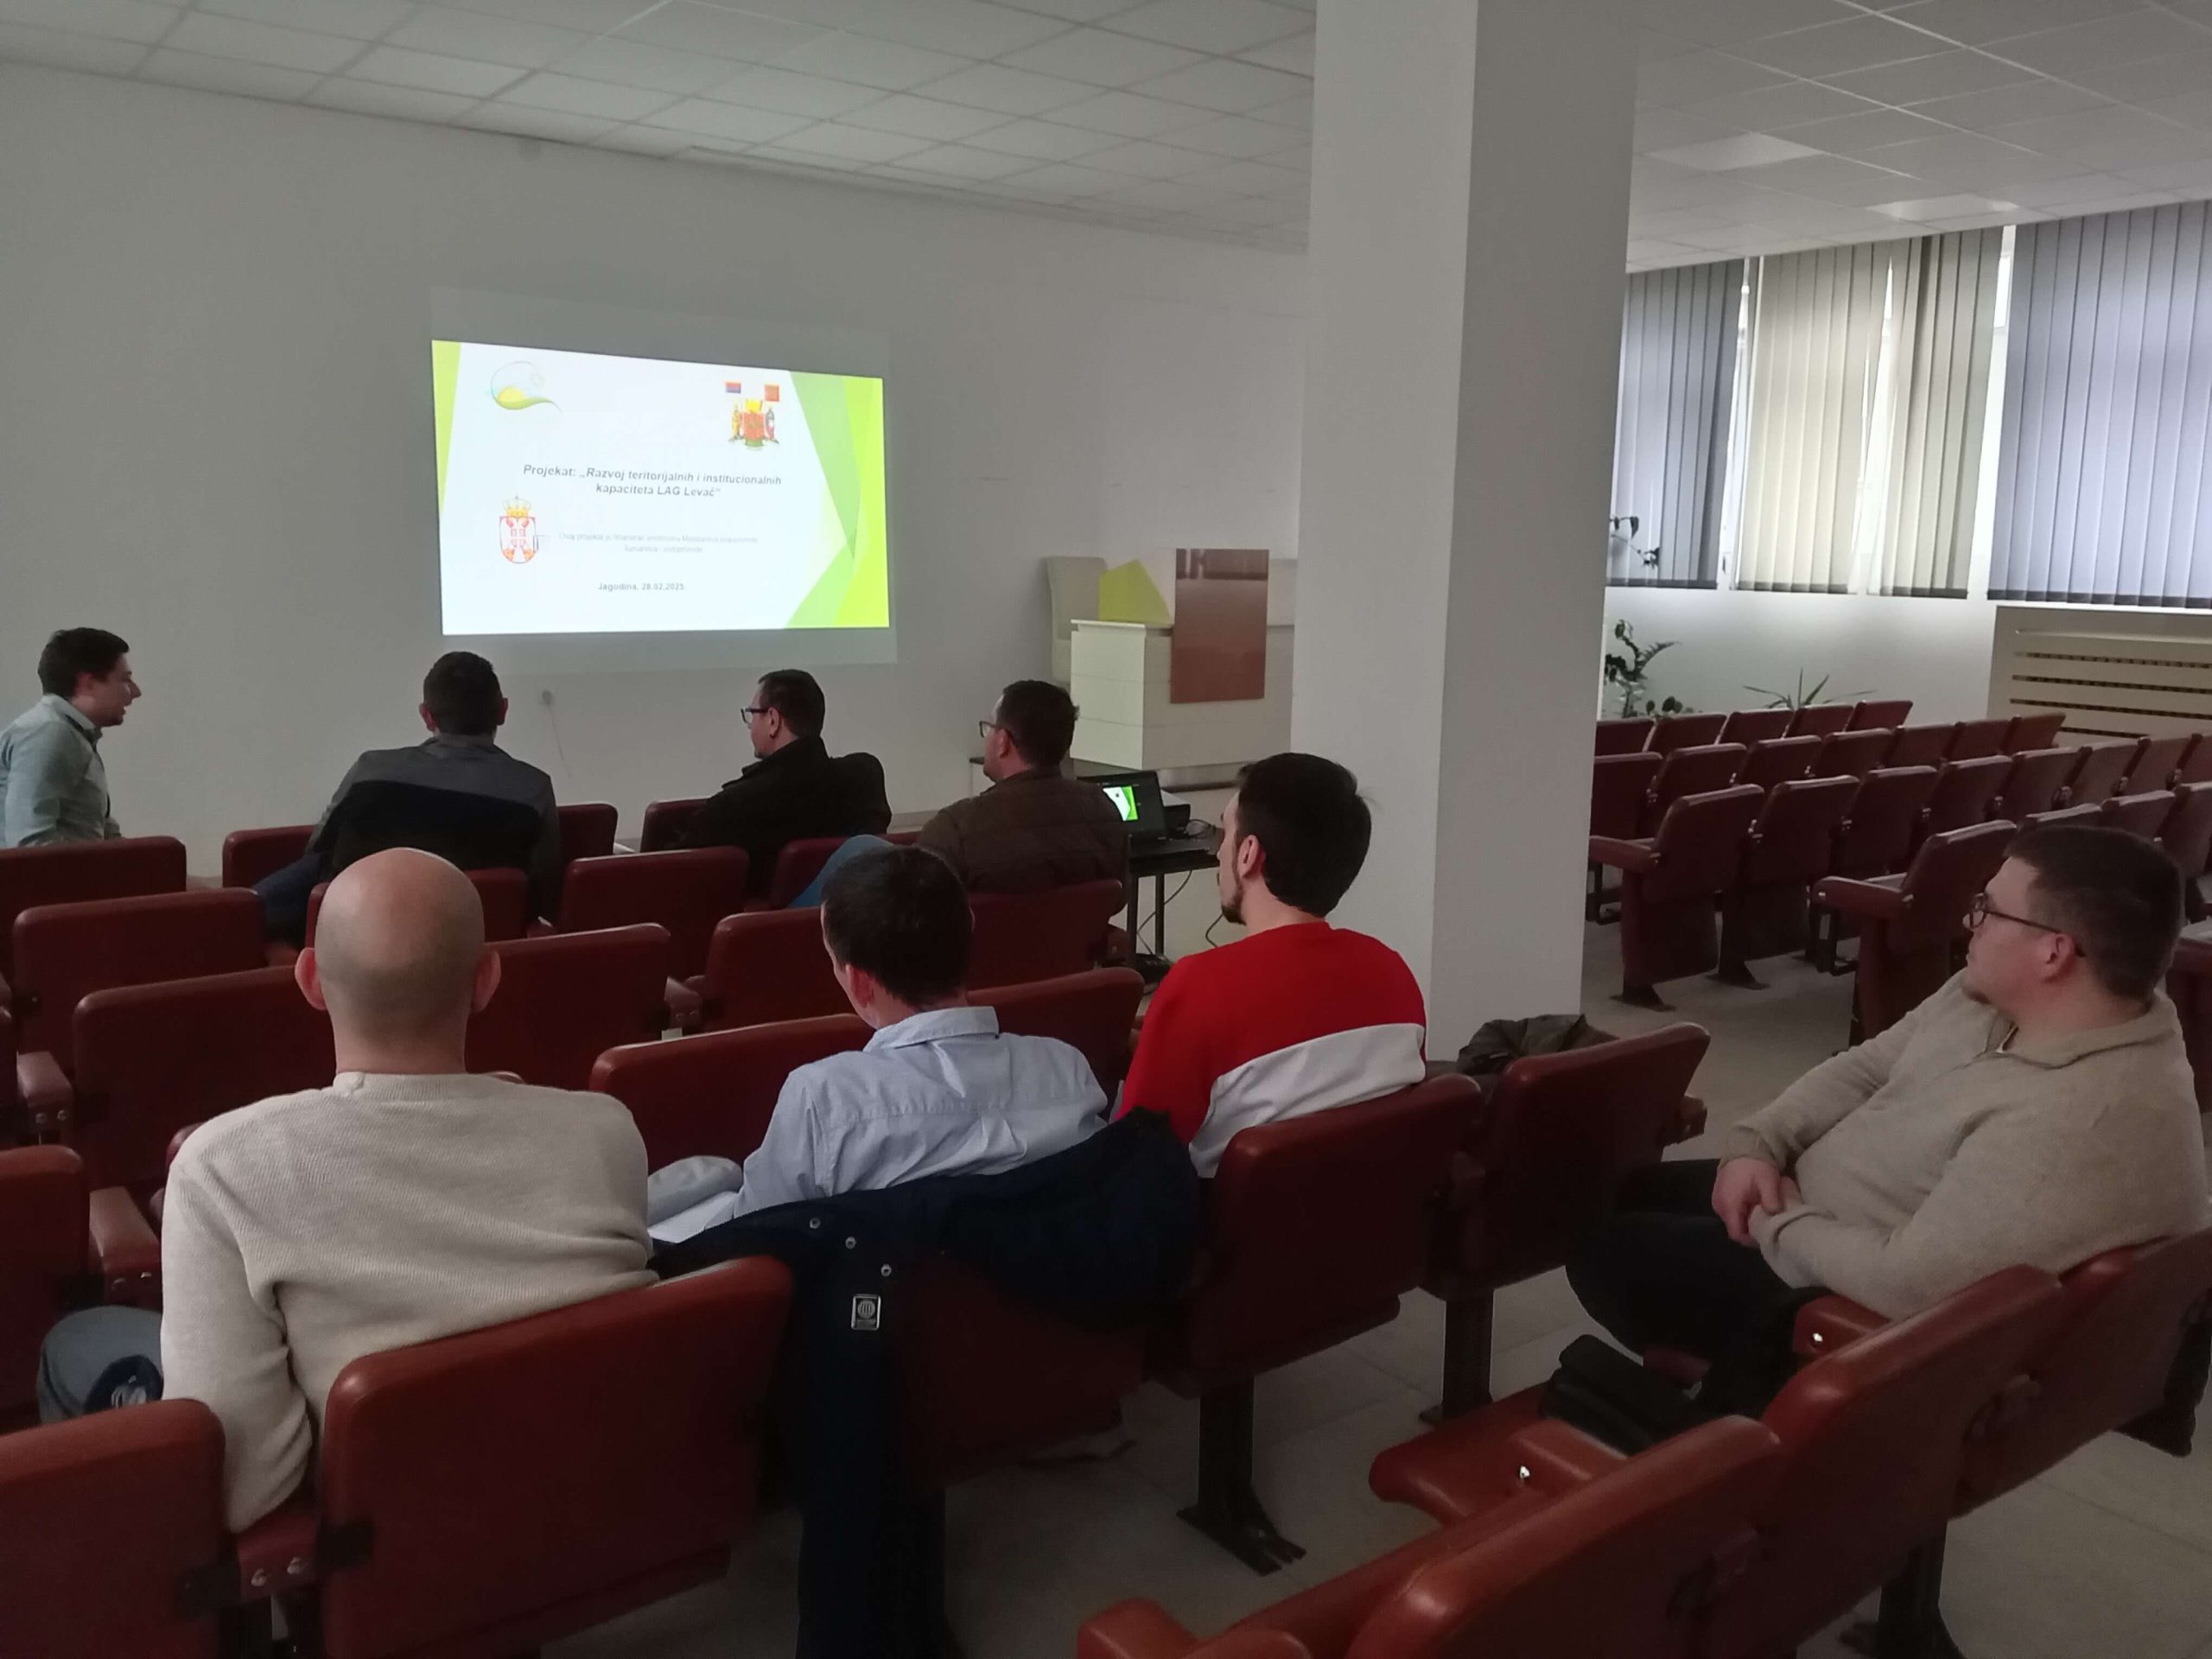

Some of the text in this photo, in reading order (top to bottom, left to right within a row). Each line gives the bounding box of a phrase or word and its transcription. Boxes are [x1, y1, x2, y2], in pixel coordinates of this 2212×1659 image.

[523, 464, 576, 477] Projekat:
[628, 471, 694, 483] teritorijalnih
[703, 474, 782, 485] institucionalnih
[595, 483, 653, 495] kapaciteta
[657, 486, 680, 495] LAG
